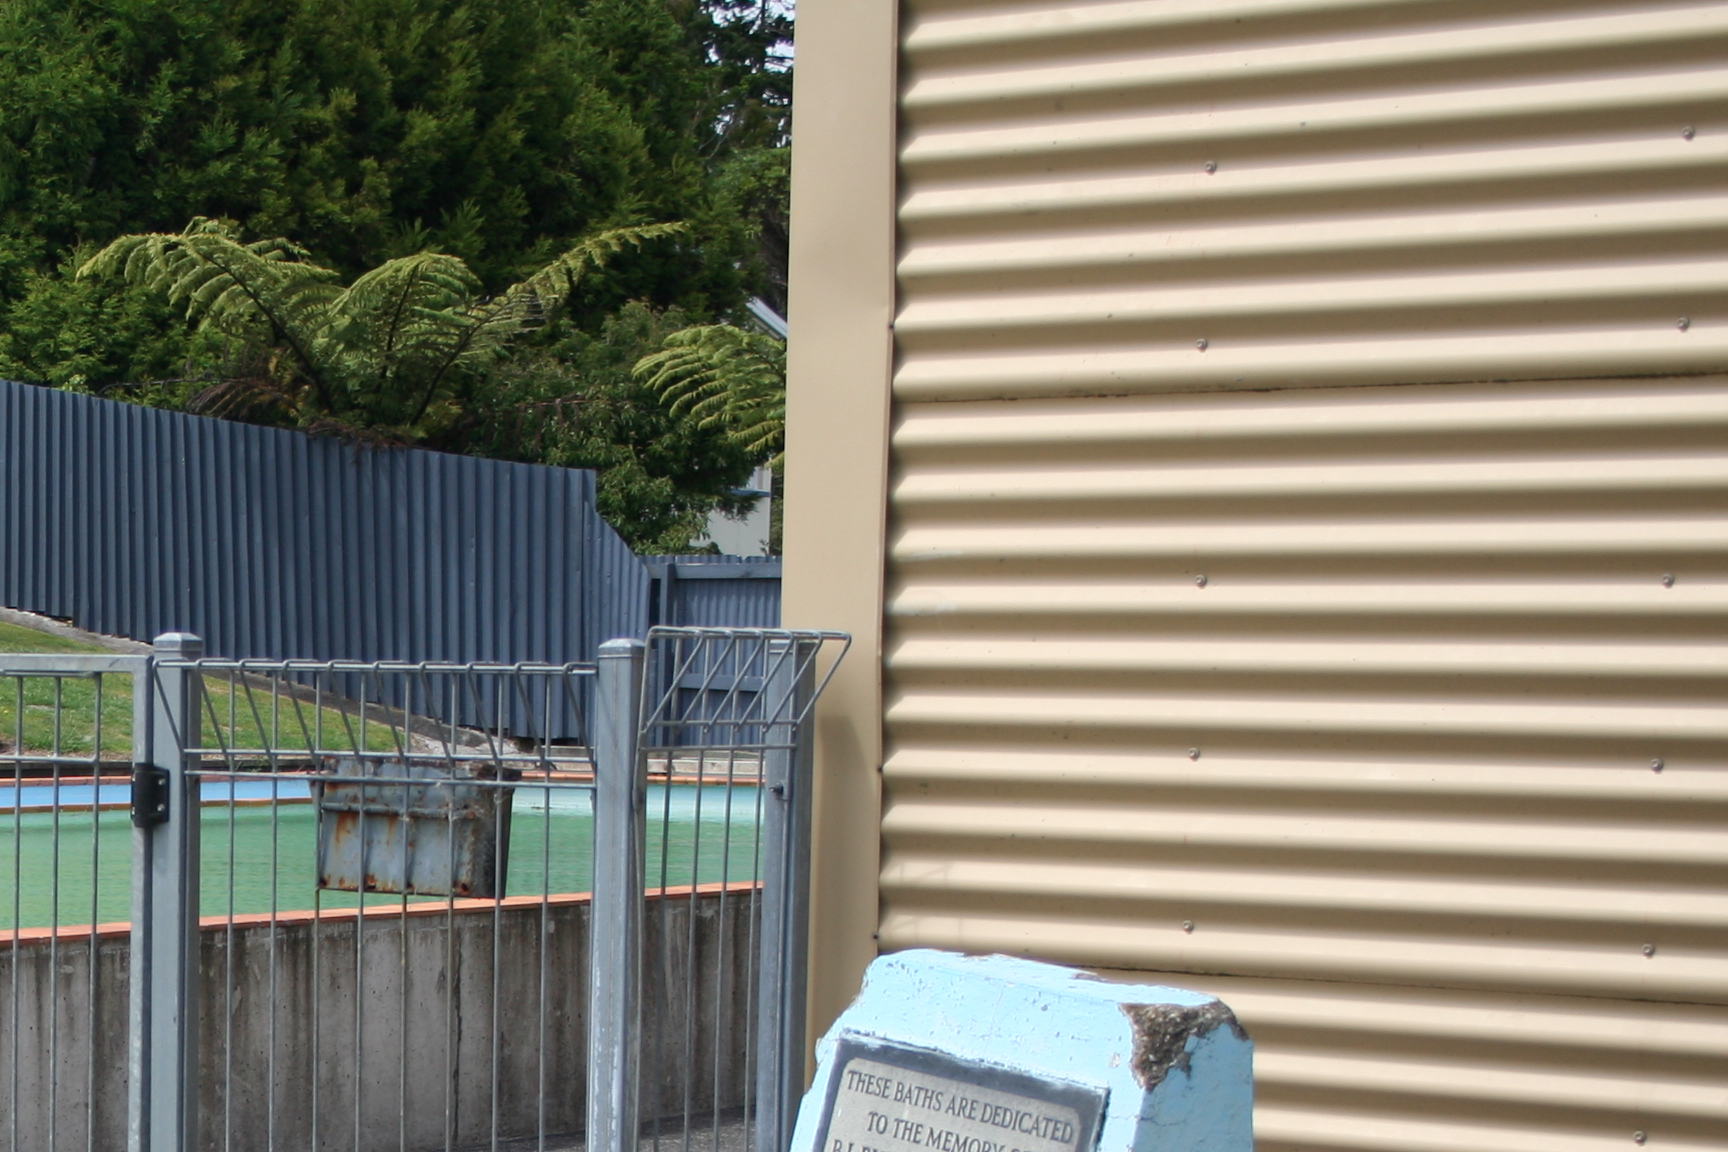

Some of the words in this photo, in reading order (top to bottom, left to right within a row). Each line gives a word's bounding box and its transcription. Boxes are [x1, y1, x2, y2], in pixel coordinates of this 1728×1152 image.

[847, 1070, 892, 1099] THESE
[893, 1081, 944, 1112] BATHS
[945, 1095, 978, 1121] ARE
[979, 1102, 1074, 1144] DEDICATED
[867, 1111, 889, 1135] TO
[893, 1118, 924, 1144] THE
